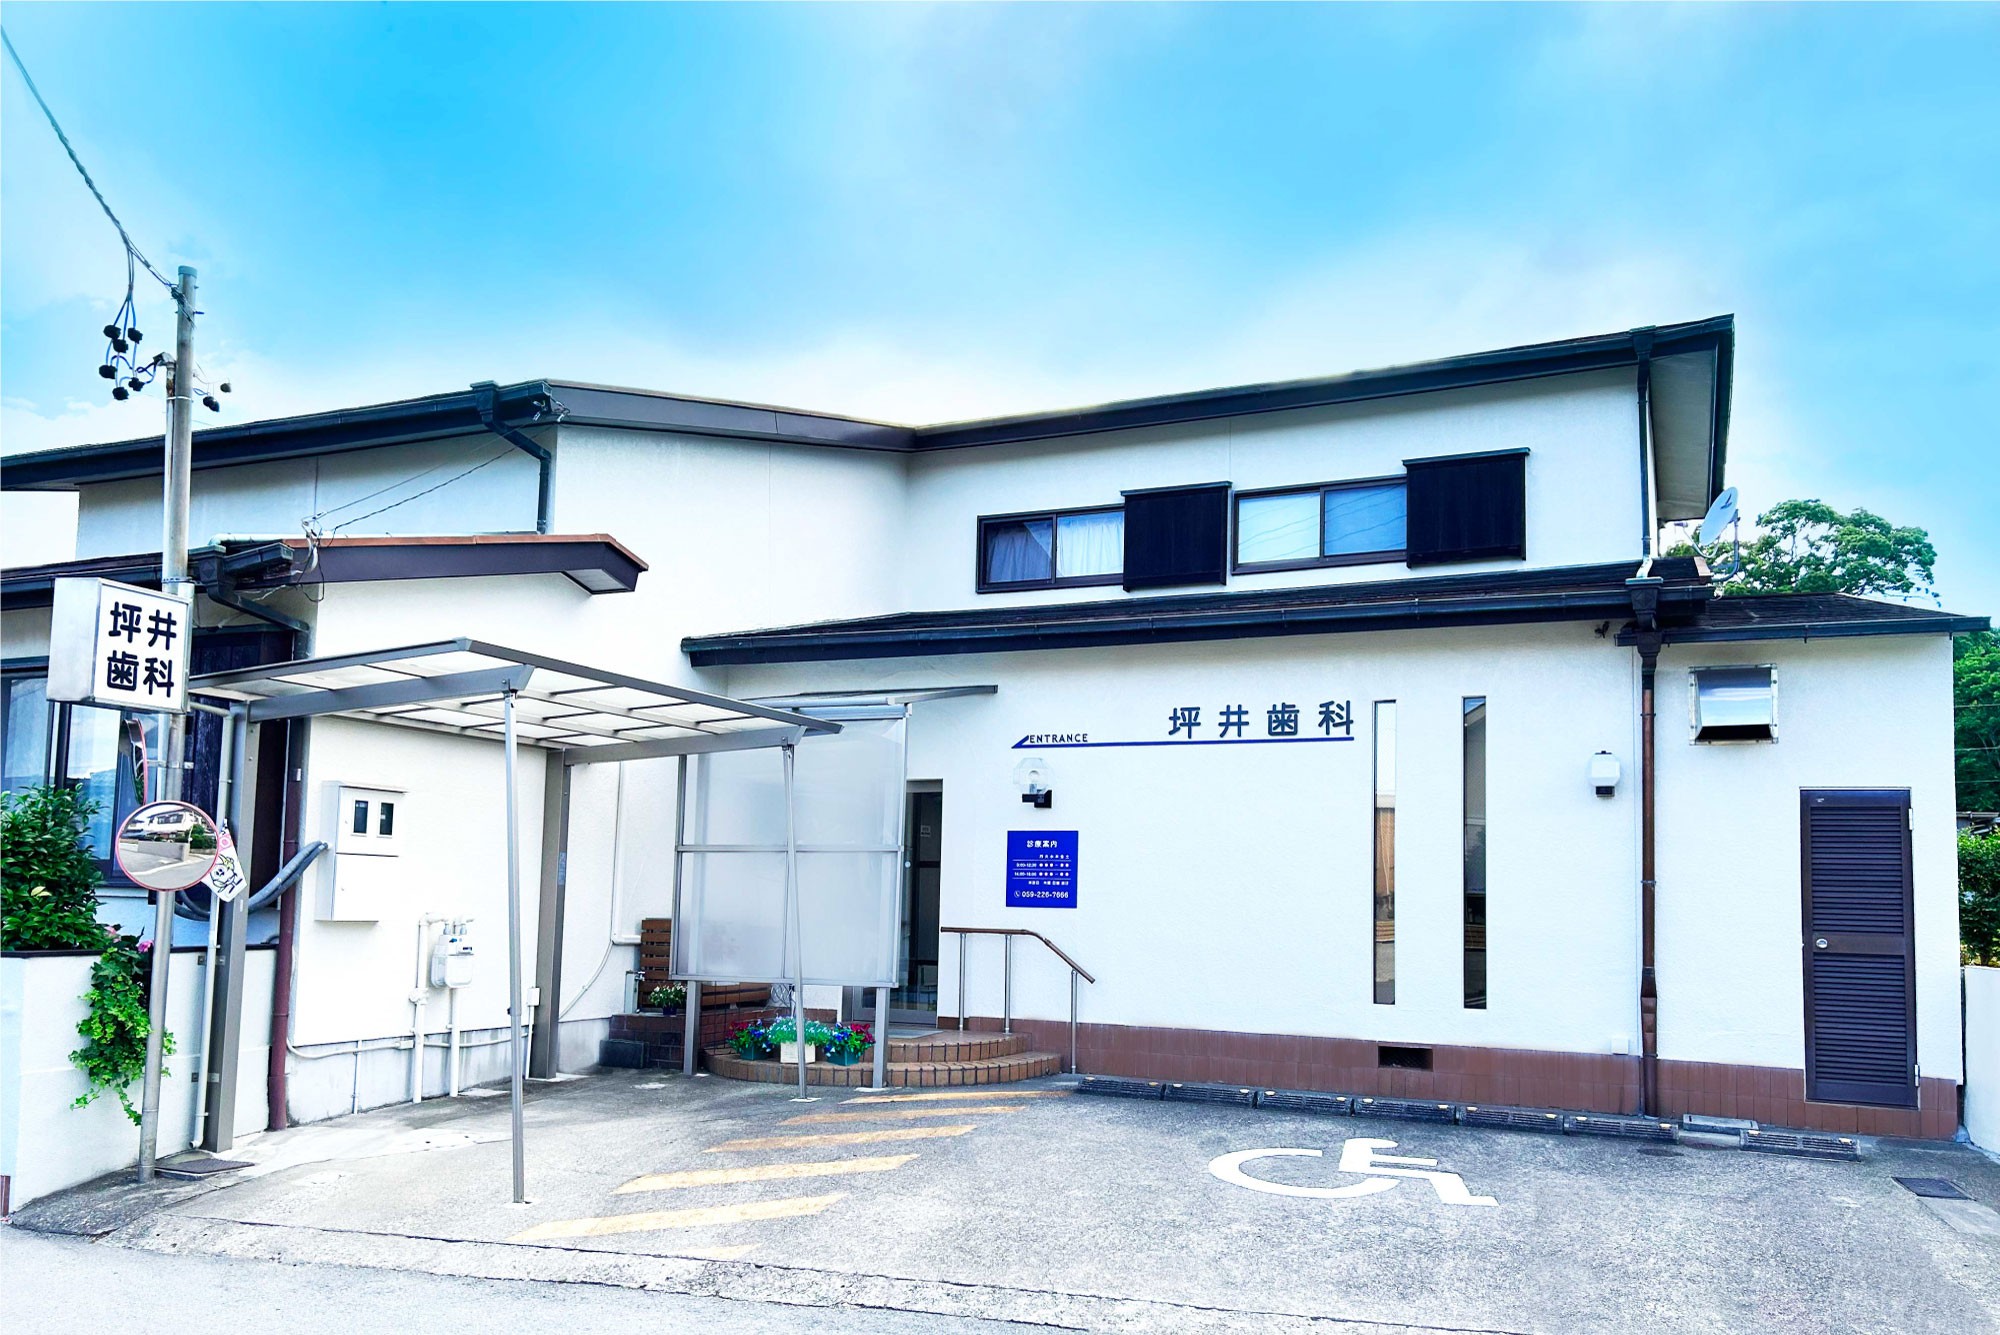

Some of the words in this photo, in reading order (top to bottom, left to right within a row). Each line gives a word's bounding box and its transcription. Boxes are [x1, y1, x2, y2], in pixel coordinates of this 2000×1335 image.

[108, 601, 177, 651] 坪井
[107, 650, 175, 698] 歯科
[1029, 733, 1088, 744] ENTRANCE
[1168, 700, 1354, 739] 坪井歯科
[1026, 840, 1058, 848] 診療案内
